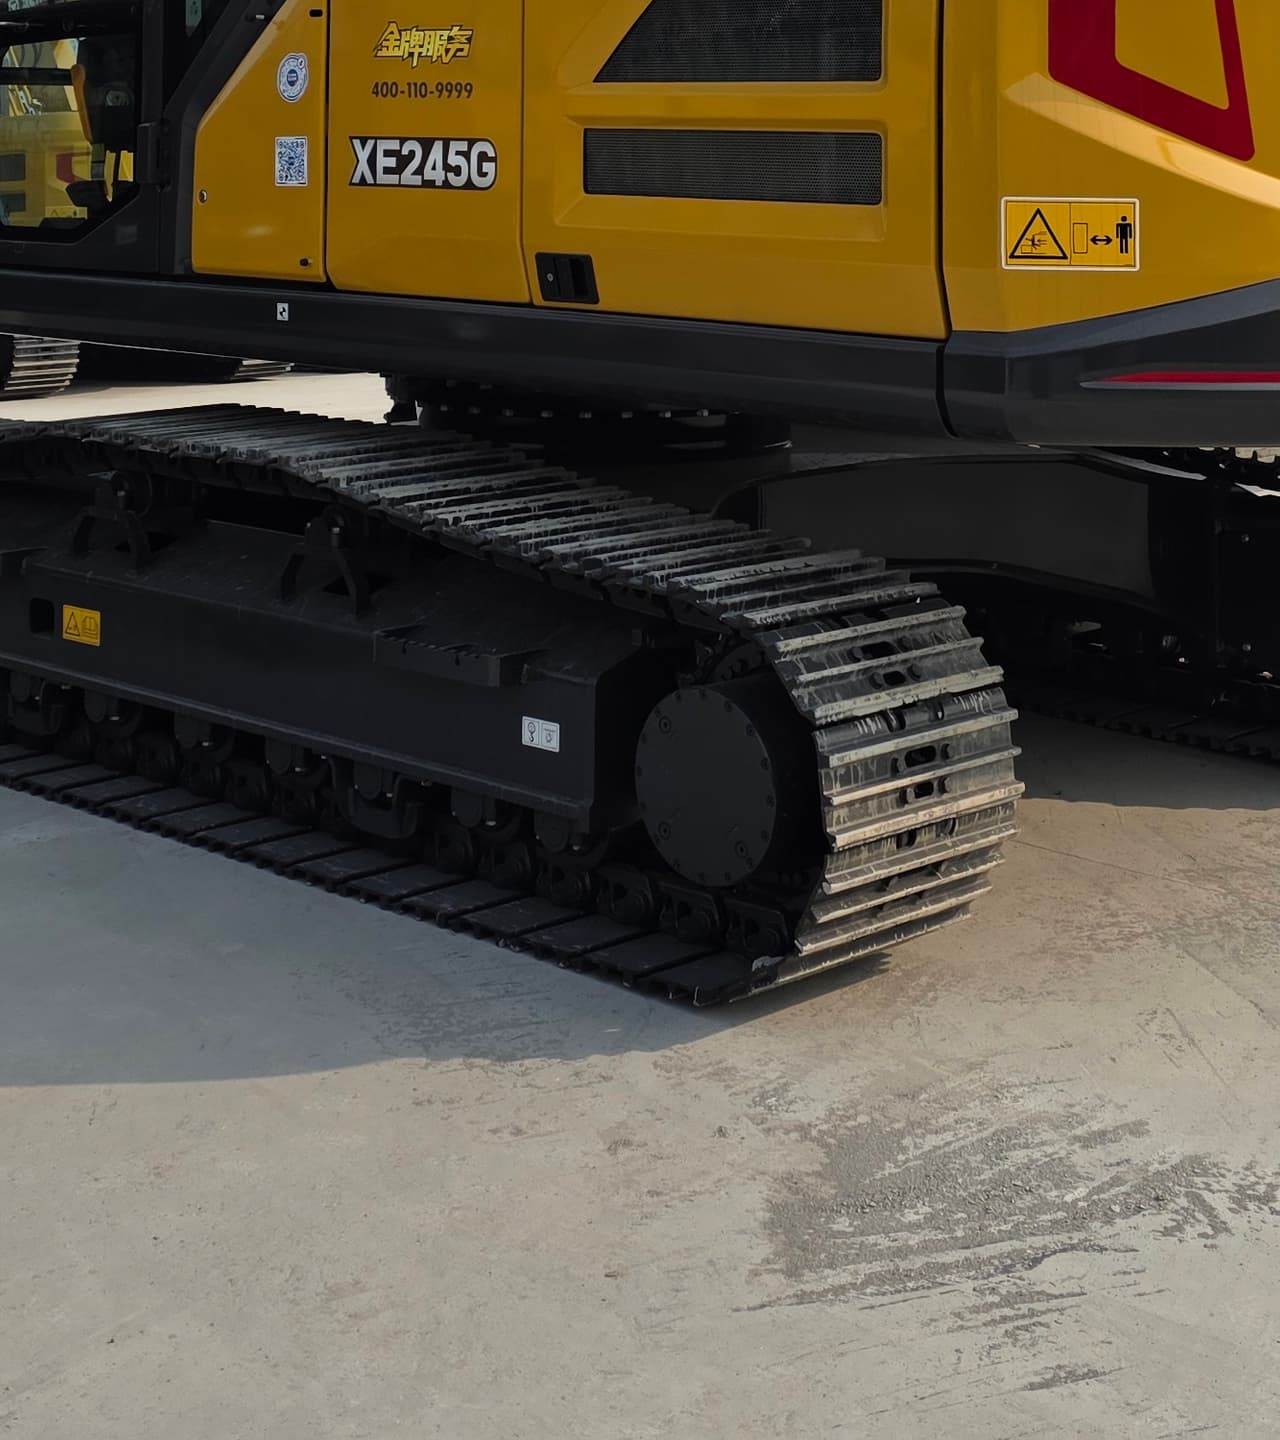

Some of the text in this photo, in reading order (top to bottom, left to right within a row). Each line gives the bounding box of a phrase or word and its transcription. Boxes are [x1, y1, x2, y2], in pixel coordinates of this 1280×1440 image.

[373, 21, 474, 68] 金牌服务
[371, 81, 474, 99] 400-110-9999
[351, 138, 496, 188] XE245G
